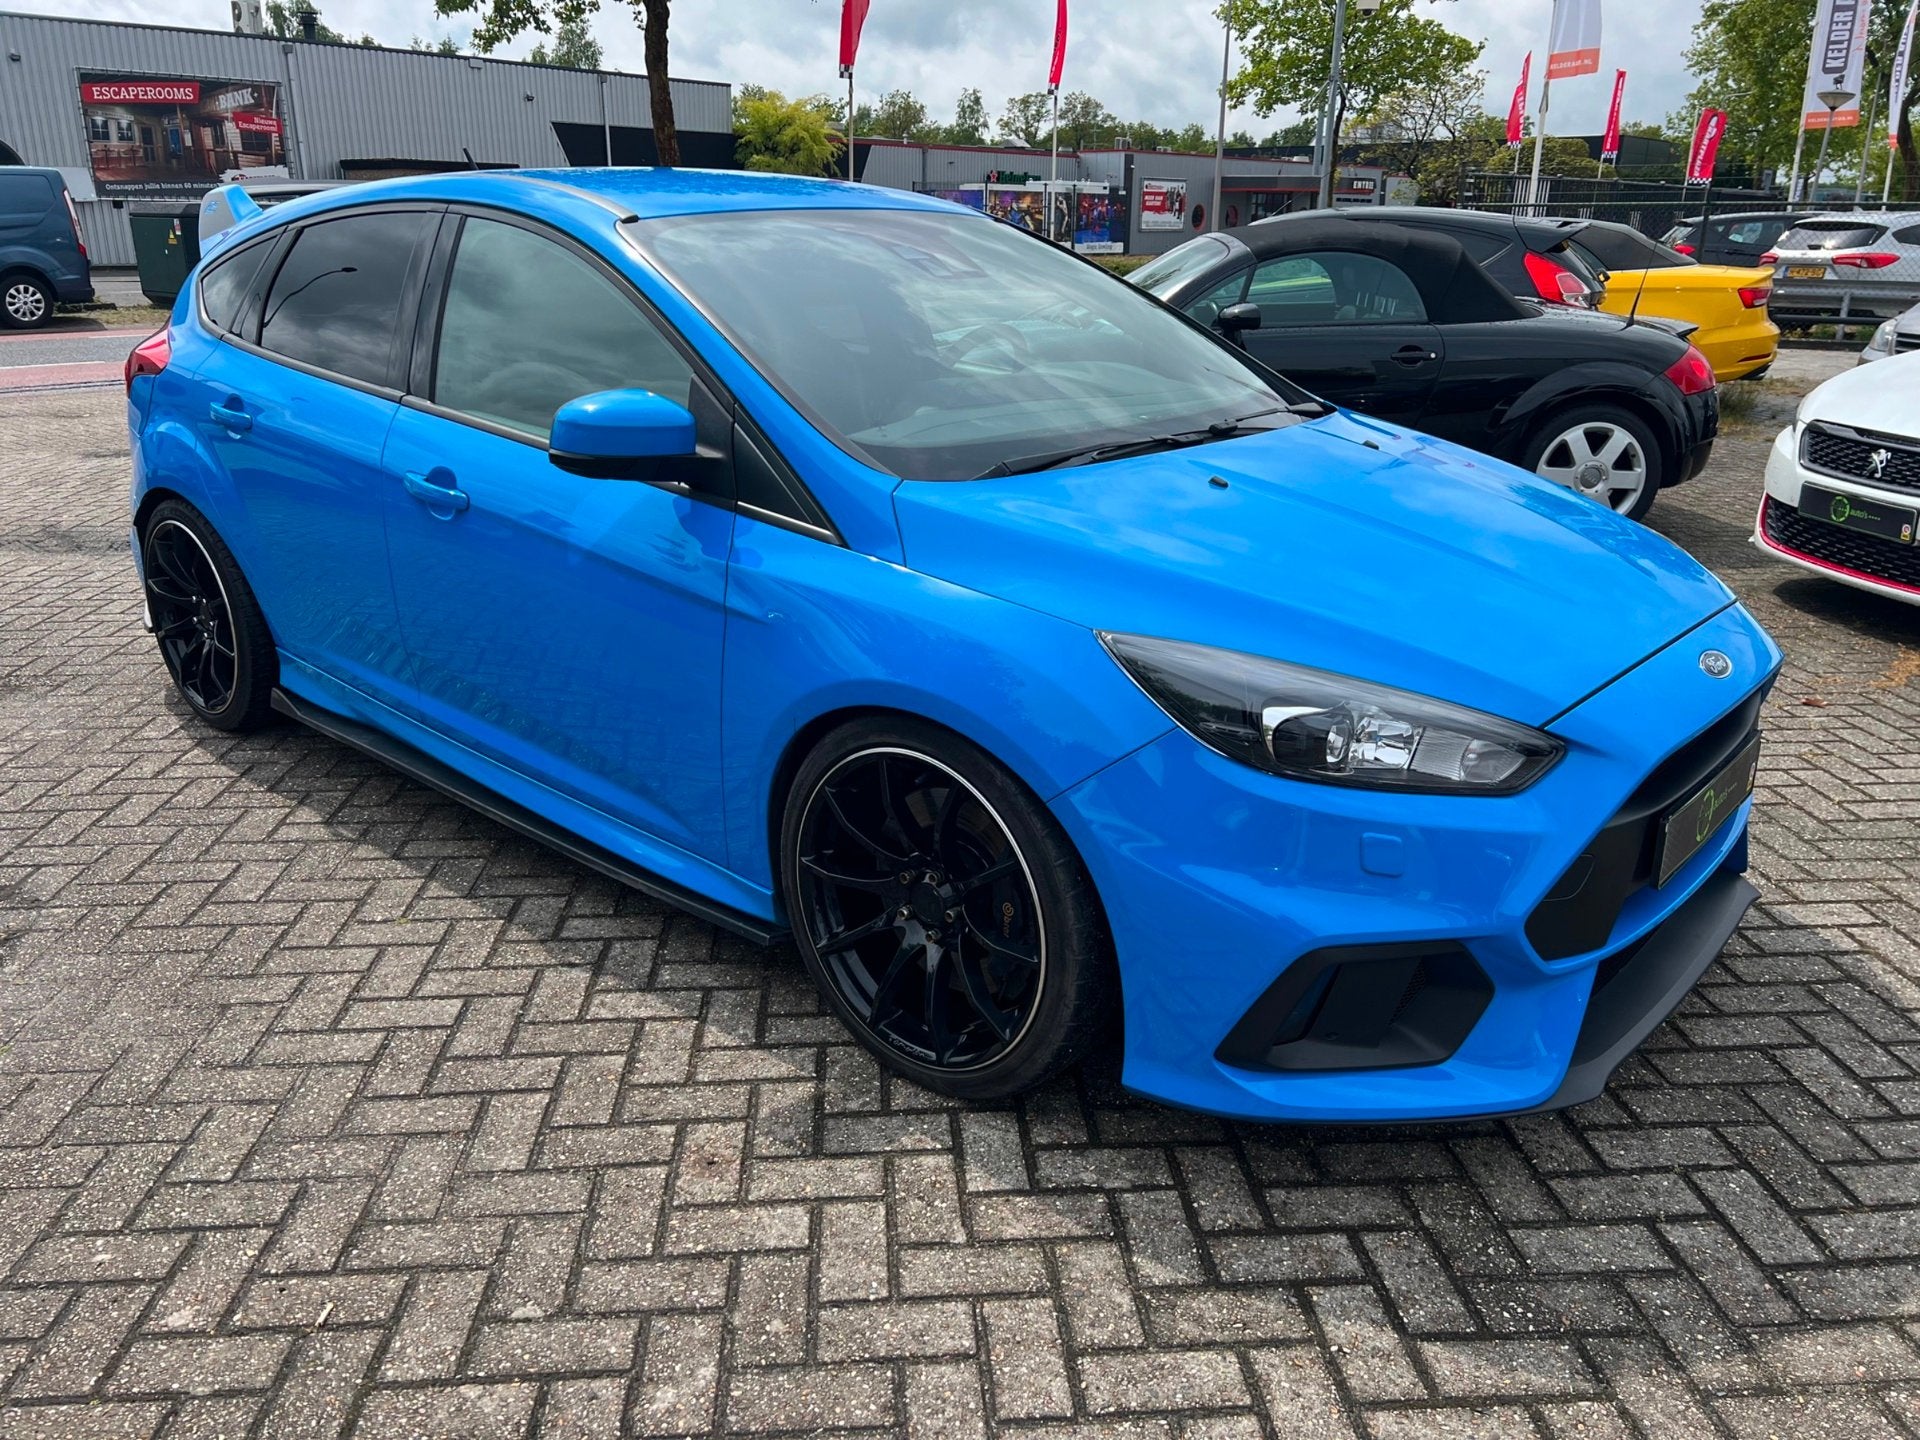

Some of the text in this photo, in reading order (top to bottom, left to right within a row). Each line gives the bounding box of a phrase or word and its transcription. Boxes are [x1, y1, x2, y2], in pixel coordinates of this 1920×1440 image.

[1825, 10, 1855, 68] KELDER
[92, 86, 194, 100] ESCAPEROOMS
[219, 88, 255, 110] BANK
